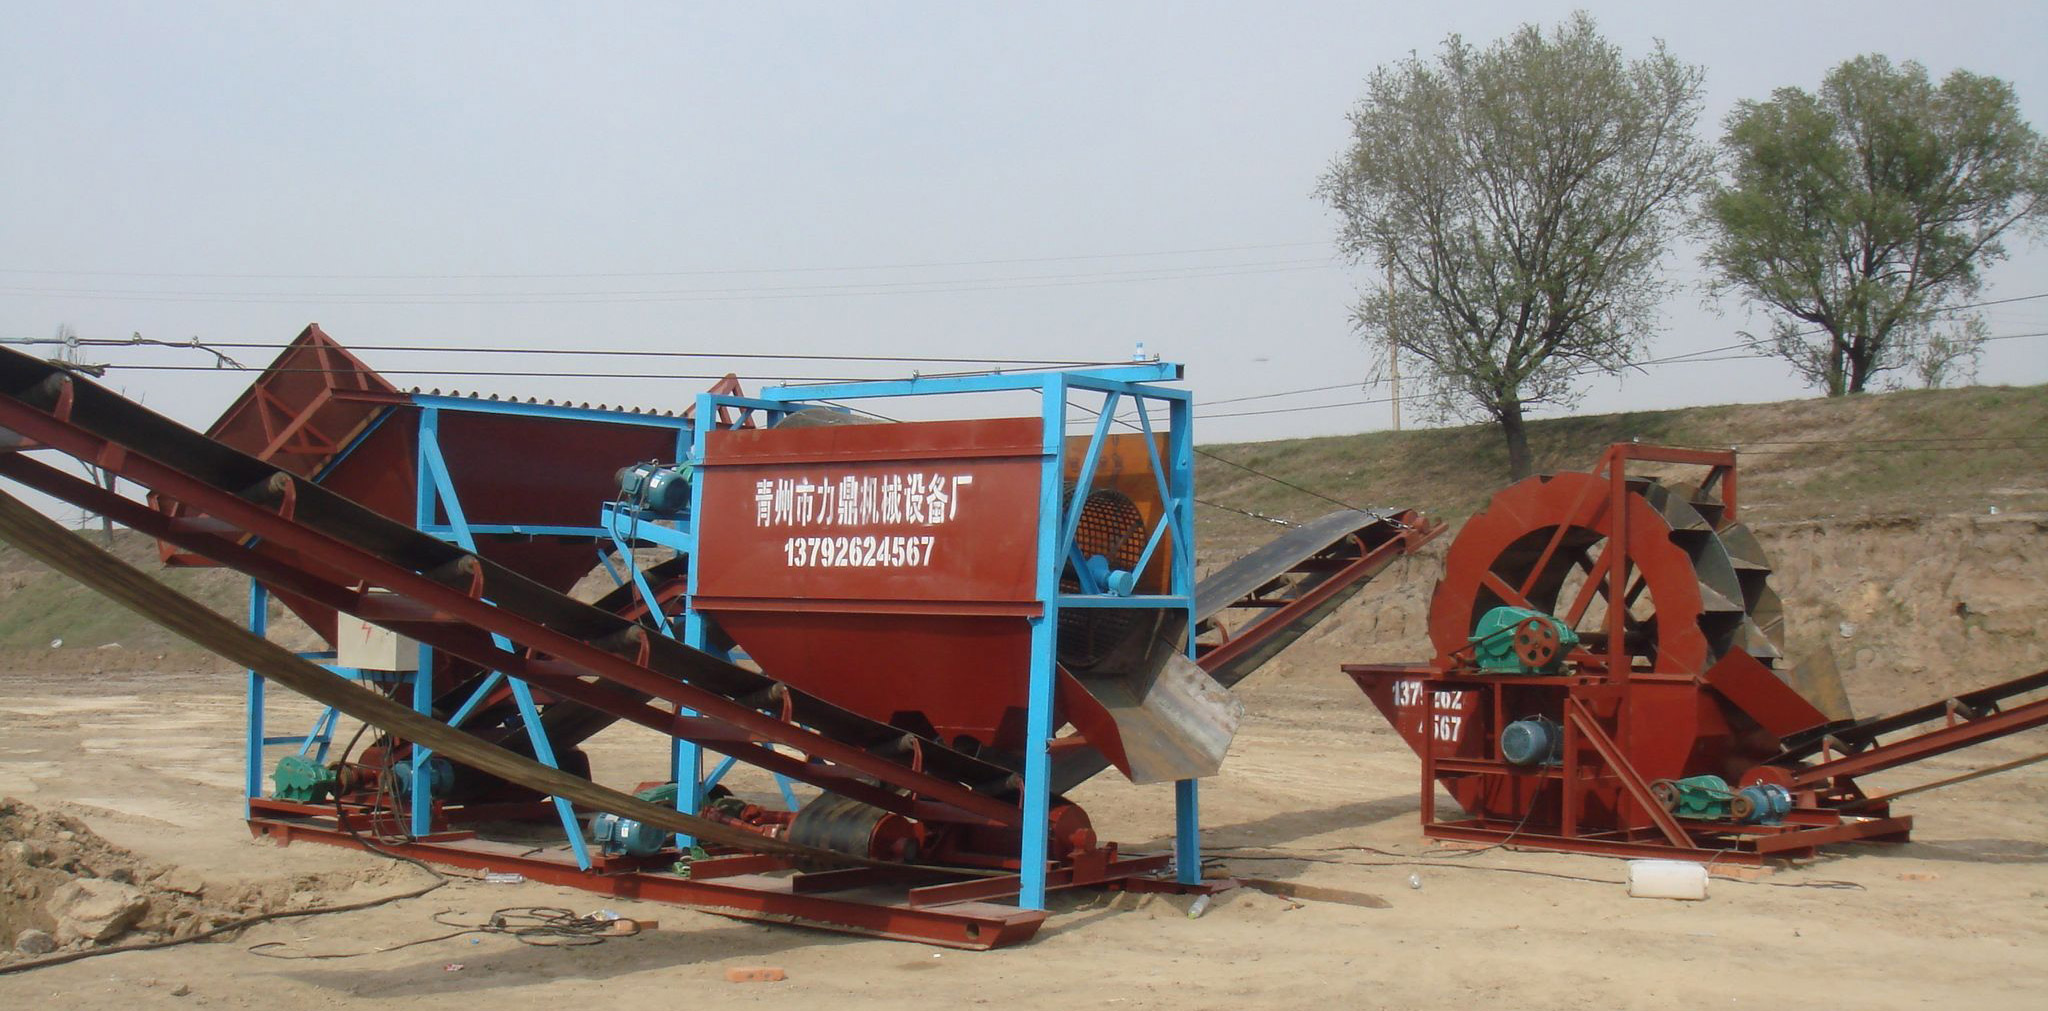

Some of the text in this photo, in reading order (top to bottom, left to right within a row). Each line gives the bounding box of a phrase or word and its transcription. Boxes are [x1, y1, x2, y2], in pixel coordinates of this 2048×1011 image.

[755, 473, 973, 527] 青州市力鼎机械设备厂
[785, 536, 935, 567] 13792624567
